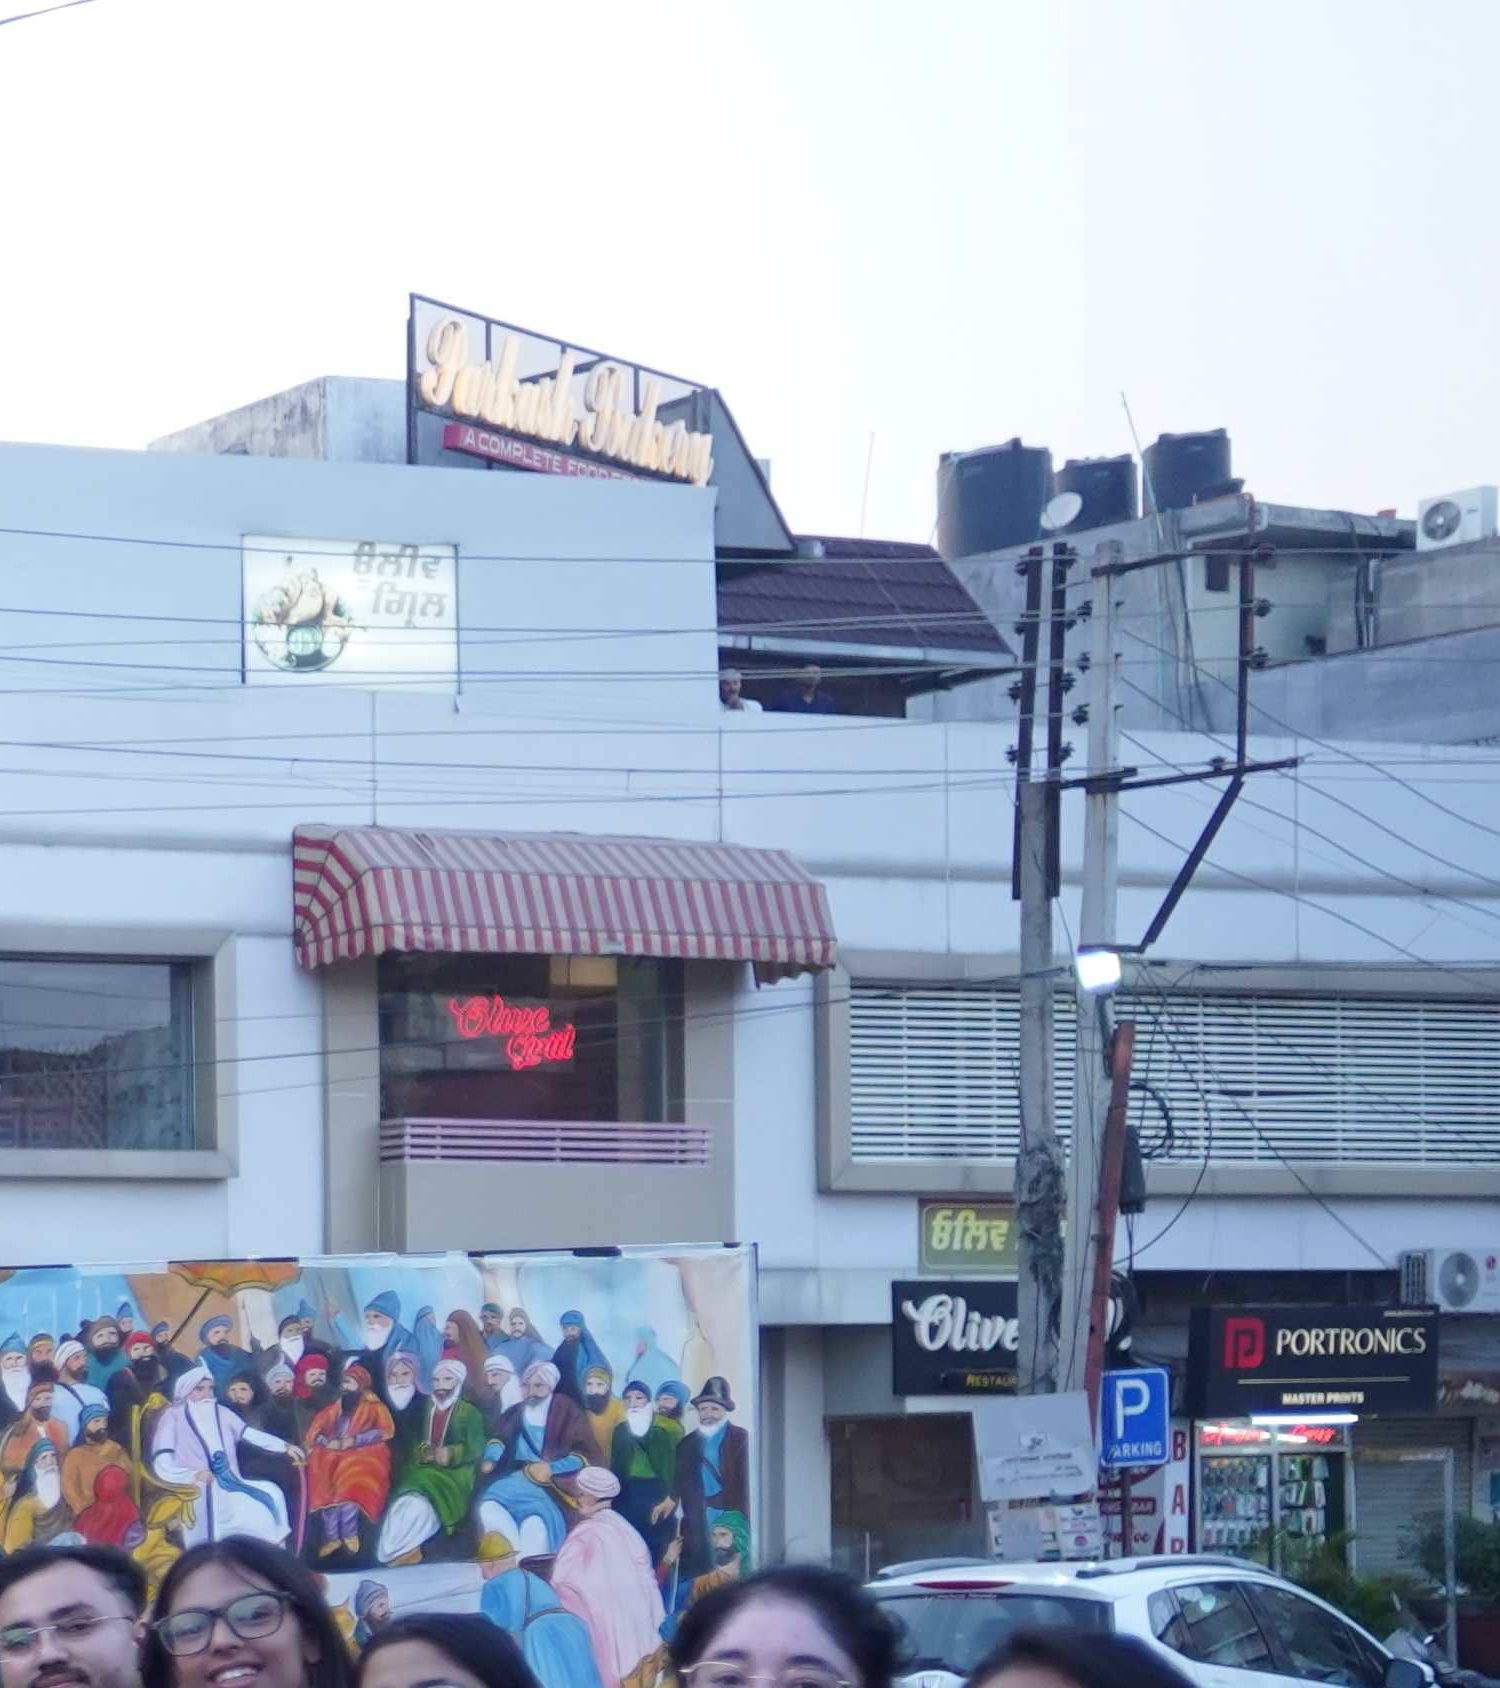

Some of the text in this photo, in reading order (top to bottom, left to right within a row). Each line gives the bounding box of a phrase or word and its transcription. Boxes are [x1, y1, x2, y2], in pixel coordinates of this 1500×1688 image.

[464, 429, 476, 446] A
[478, 435, 561, 473] COMPLETE
[449, 996, 550, 1037] Olive
[1276, 1327, 1427, 1356] PORTRONICS
[1116, 1379, 1150, 1439] P
[1282, 1391, 1365, 1405] MASTER PRINTS
